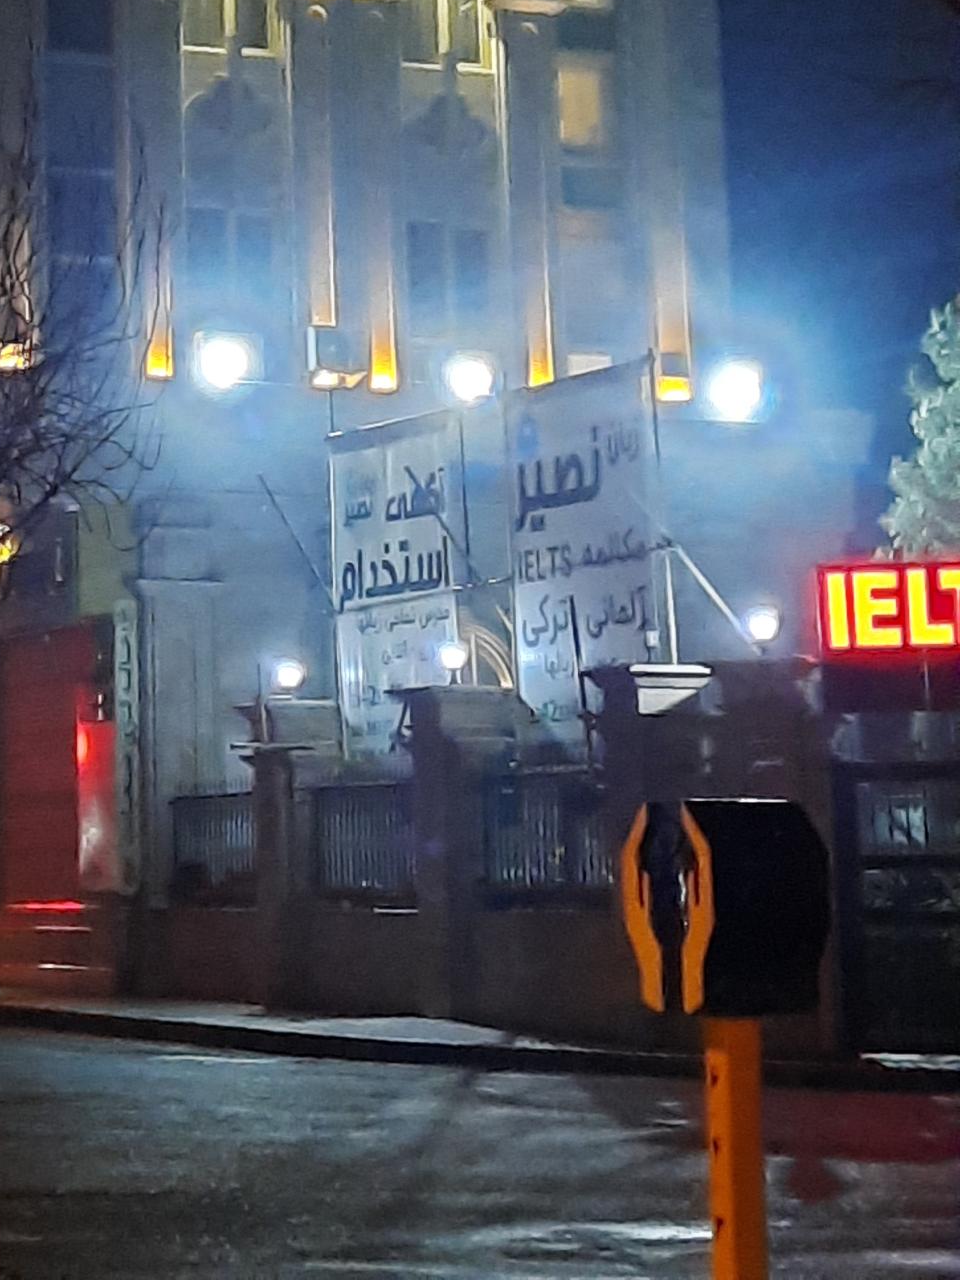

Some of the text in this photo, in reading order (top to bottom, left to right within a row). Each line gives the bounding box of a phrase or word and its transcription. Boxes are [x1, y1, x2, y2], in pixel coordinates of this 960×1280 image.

[514, 425, 604, 533] نصیر
[338, 534, 452, 615] استخدام
[517, 543, 572, 584] IELTS
[523, 593, 568, 648] ترکی
